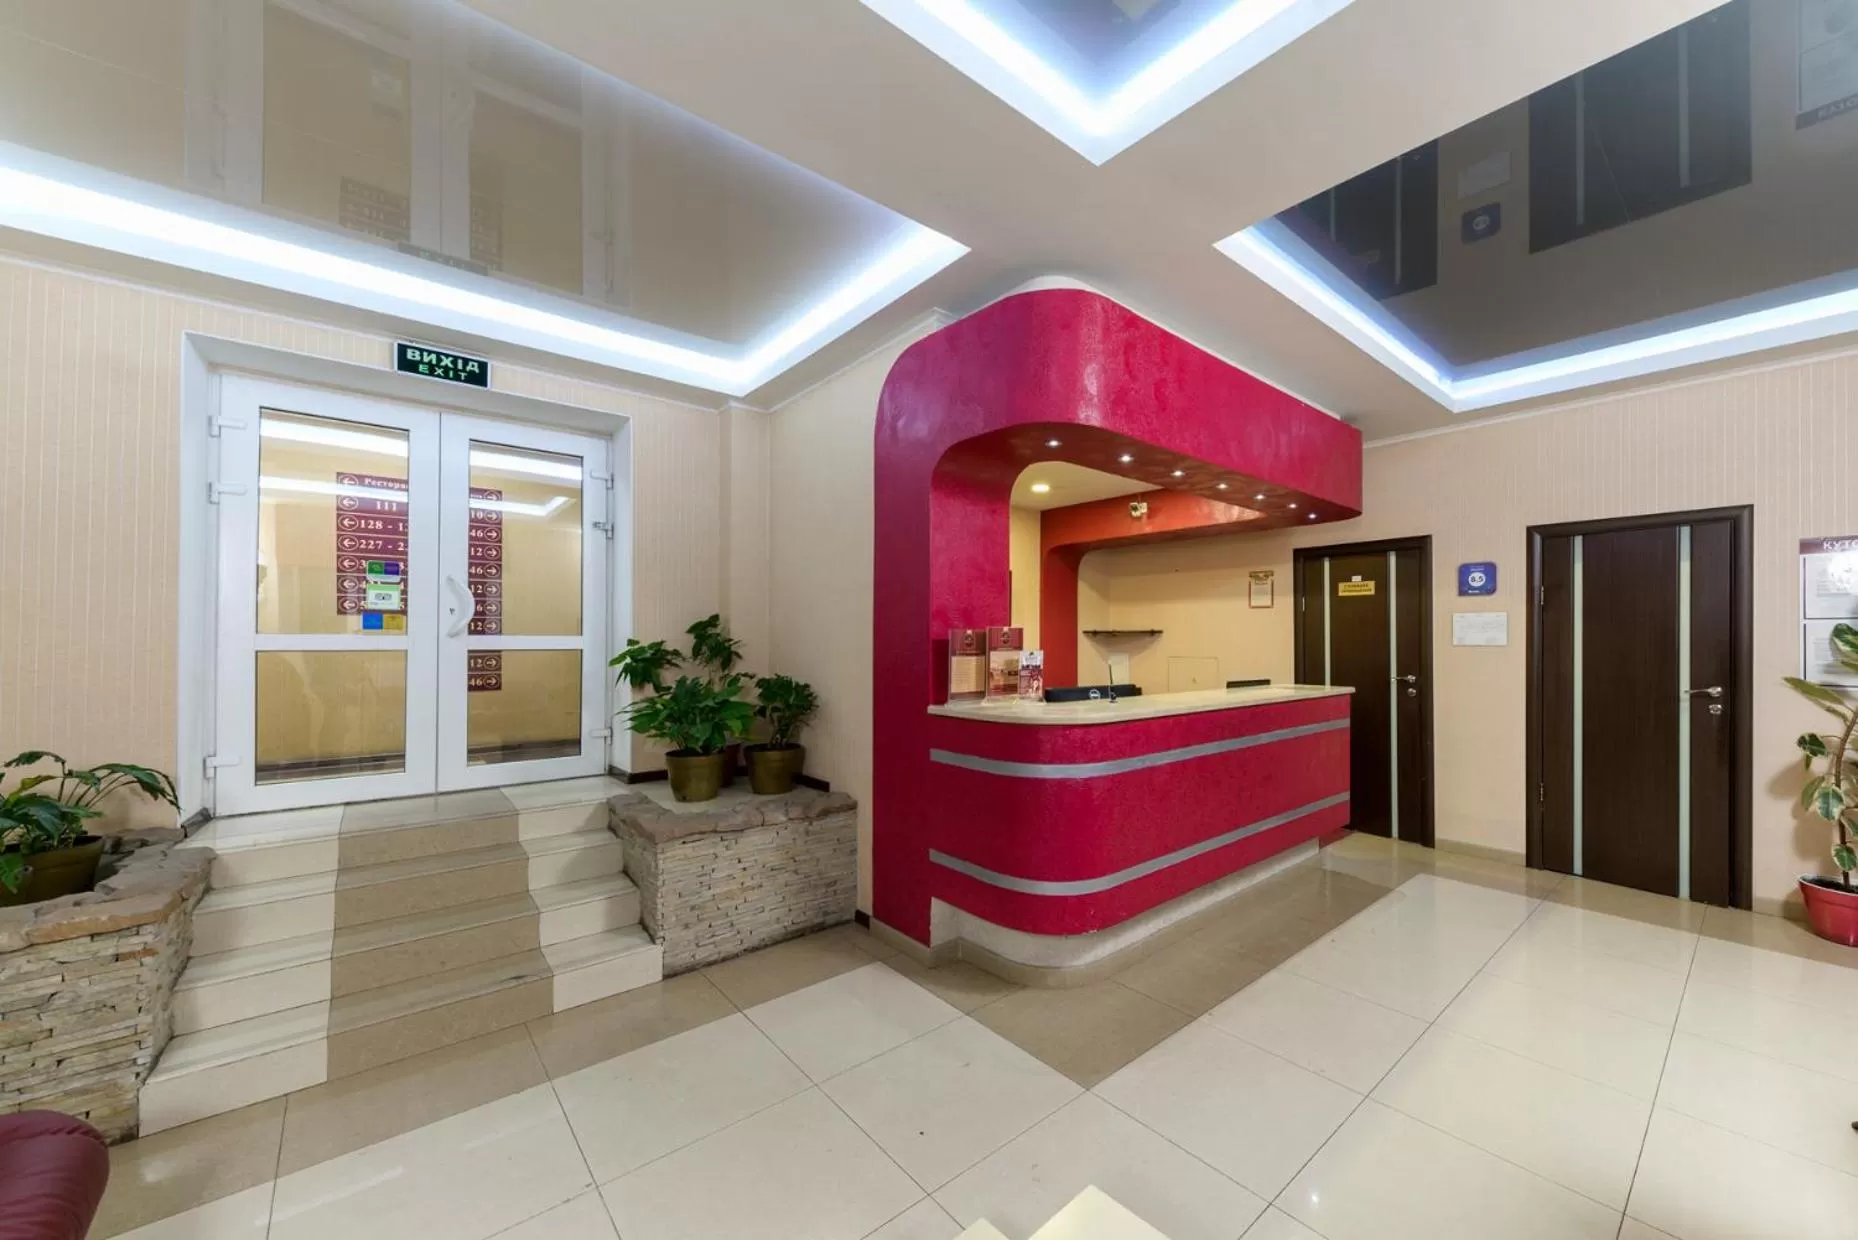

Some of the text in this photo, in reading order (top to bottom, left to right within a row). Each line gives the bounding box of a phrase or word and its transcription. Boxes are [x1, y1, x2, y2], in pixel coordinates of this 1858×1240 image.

[406, 348, 480, 374] ВИХІД
[418, 363, 468, 381] EXIT
[376, 501, 397, 511] 111
[360, 519, 384, 530] 128
[359, 540, 383, 551] 227
